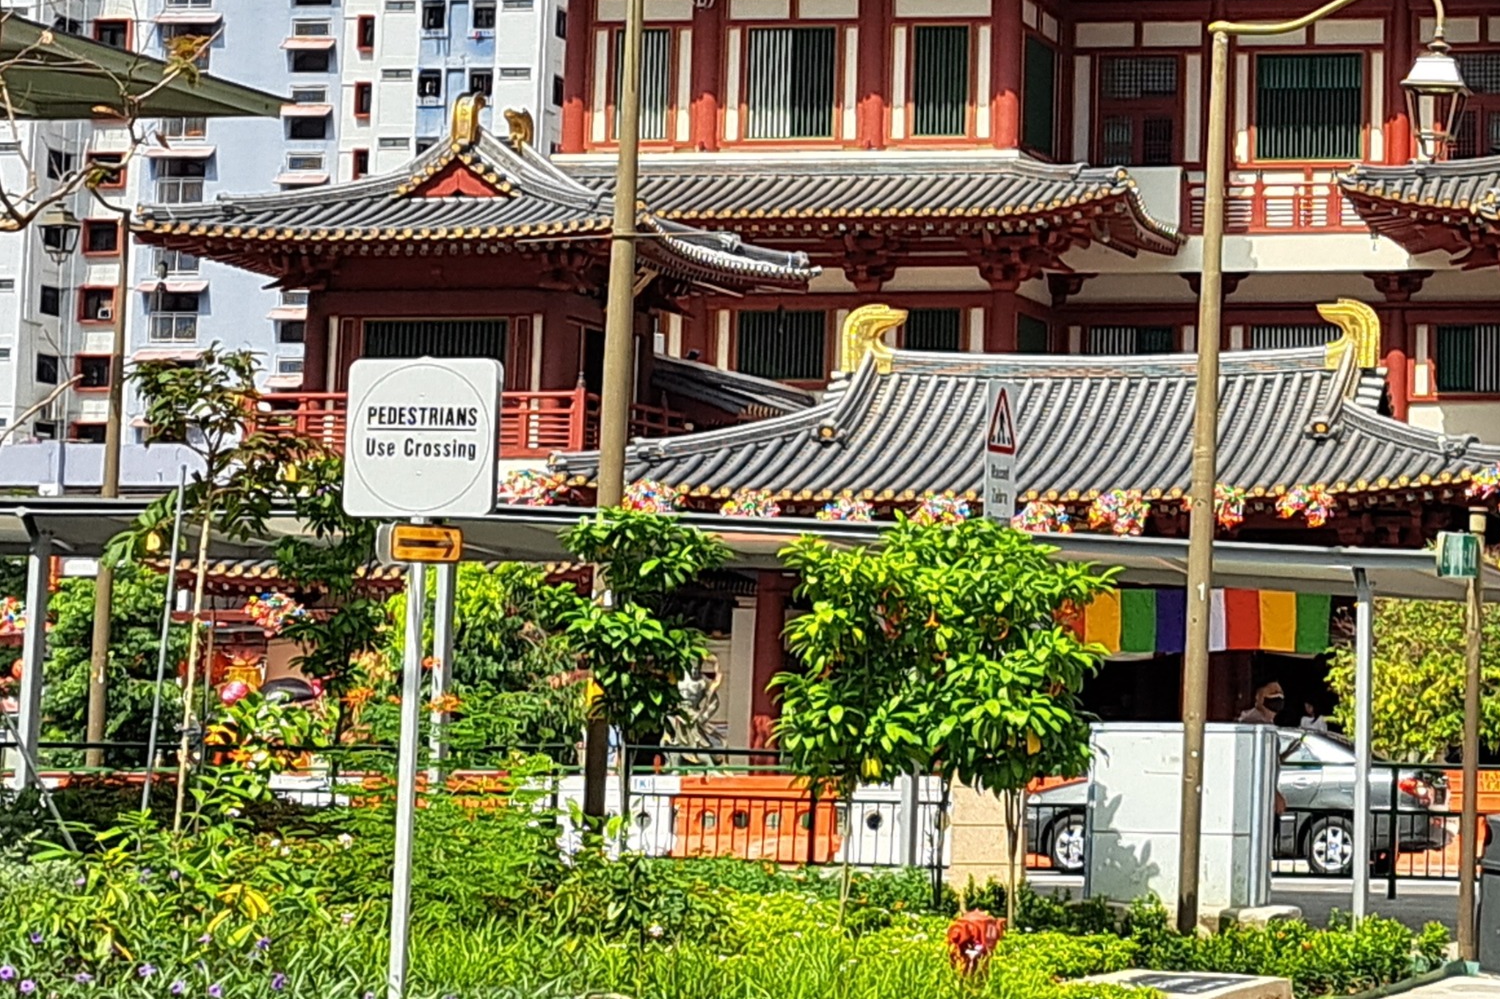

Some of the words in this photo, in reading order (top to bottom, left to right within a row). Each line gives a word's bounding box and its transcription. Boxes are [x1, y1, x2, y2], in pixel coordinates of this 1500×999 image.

[367, 405, 478, 427] PEDESTRIANS
[365, 437, 395, 457] Use
[404, 437, 477, 461] Crossing
